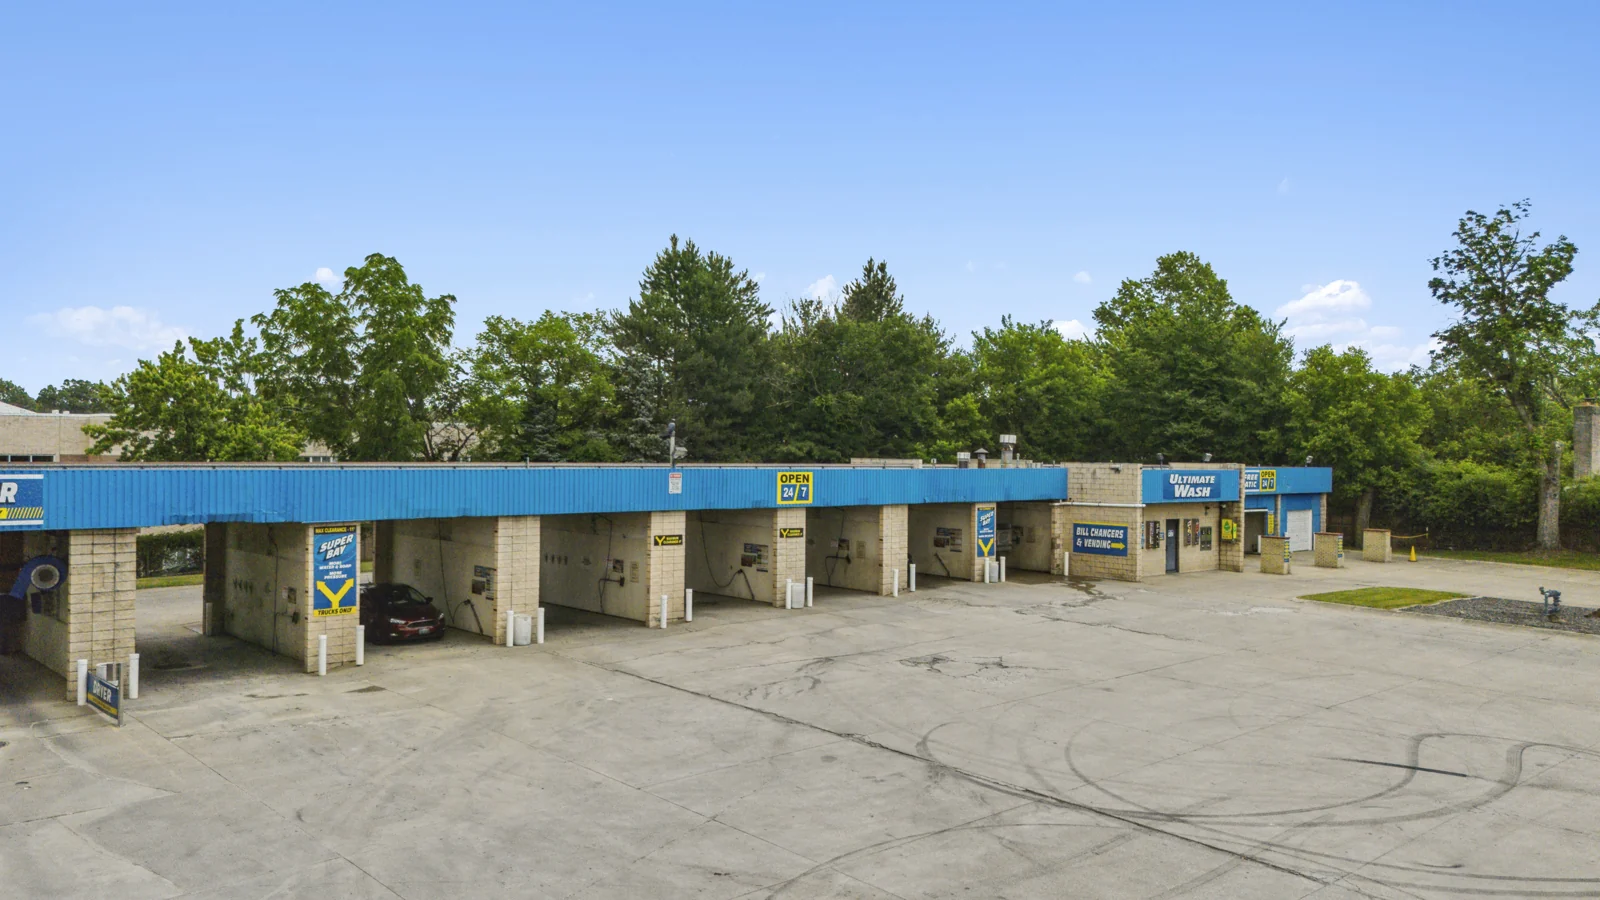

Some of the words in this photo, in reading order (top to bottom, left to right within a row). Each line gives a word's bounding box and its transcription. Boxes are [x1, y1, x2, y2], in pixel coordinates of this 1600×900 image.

[780, 474, 810, 483] OPEN
[1169, 474, 1216, 484] ULTIMATE
[1174, 485, 1211, 498] WASH
[1076, 527, 1089, 536] BILL
[1090, 528, 1124, 539] CHANGERS
[319, 534, 354, 553] SUPER
[1076, 538, 1082, 547] &
[1084, 539, 1111, 549] VENDING
[325, 545, 346, 560] BAY
[93, 680, 111, 703] DRYER
